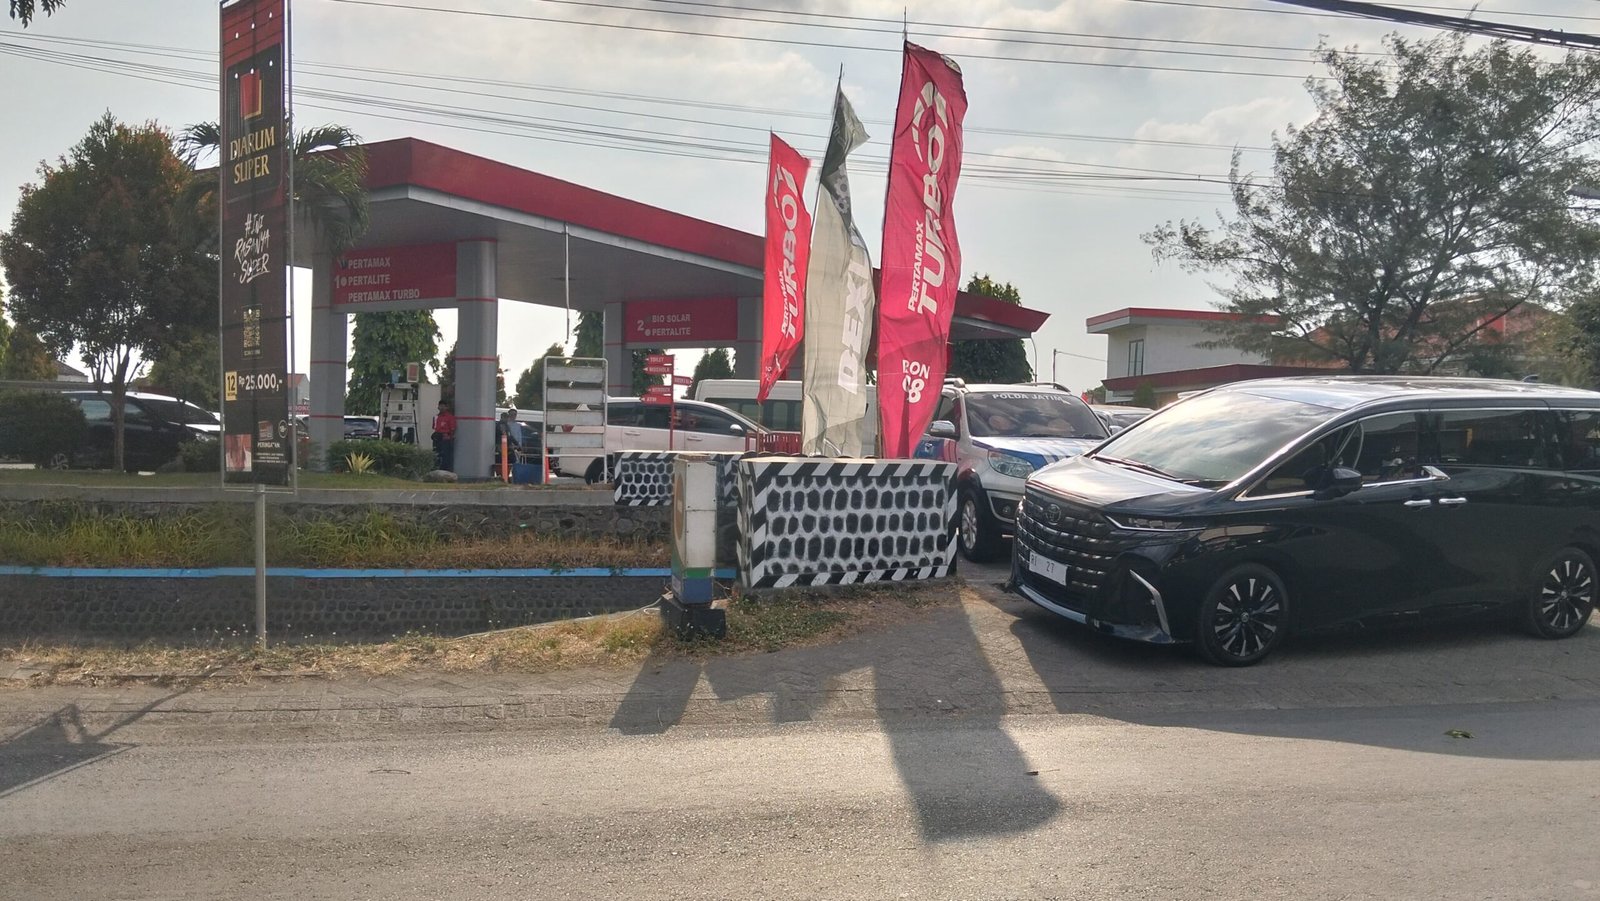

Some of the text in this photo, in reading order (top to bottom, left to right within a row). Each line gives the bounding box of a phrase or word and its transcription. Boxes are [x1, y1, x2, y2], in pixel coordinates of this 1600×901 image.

[233, 154, 270, 184] SUPER
[917, 124, 946, 315] TURBO
[233, 228, 271, 264] RASANYA
[239, 253, 271, 284] SUPER
[347, 257, 391, 269] PERTAMAX
[781, 194, 799, 340] TURBO
[907, 219, 925, 312] PERTAMAX
[348, 274, 391, 286] PERTALITE
[348, 288, 420, 302] PERTAMAX TURBO
[637, 320, 645, 331] 2
[666, 313, 691, 322] SOLAR
[652, 328, 691, 336] PERTALITE
[902, 360, 930, 379] RON
[227, 375, 236, 391] 12
